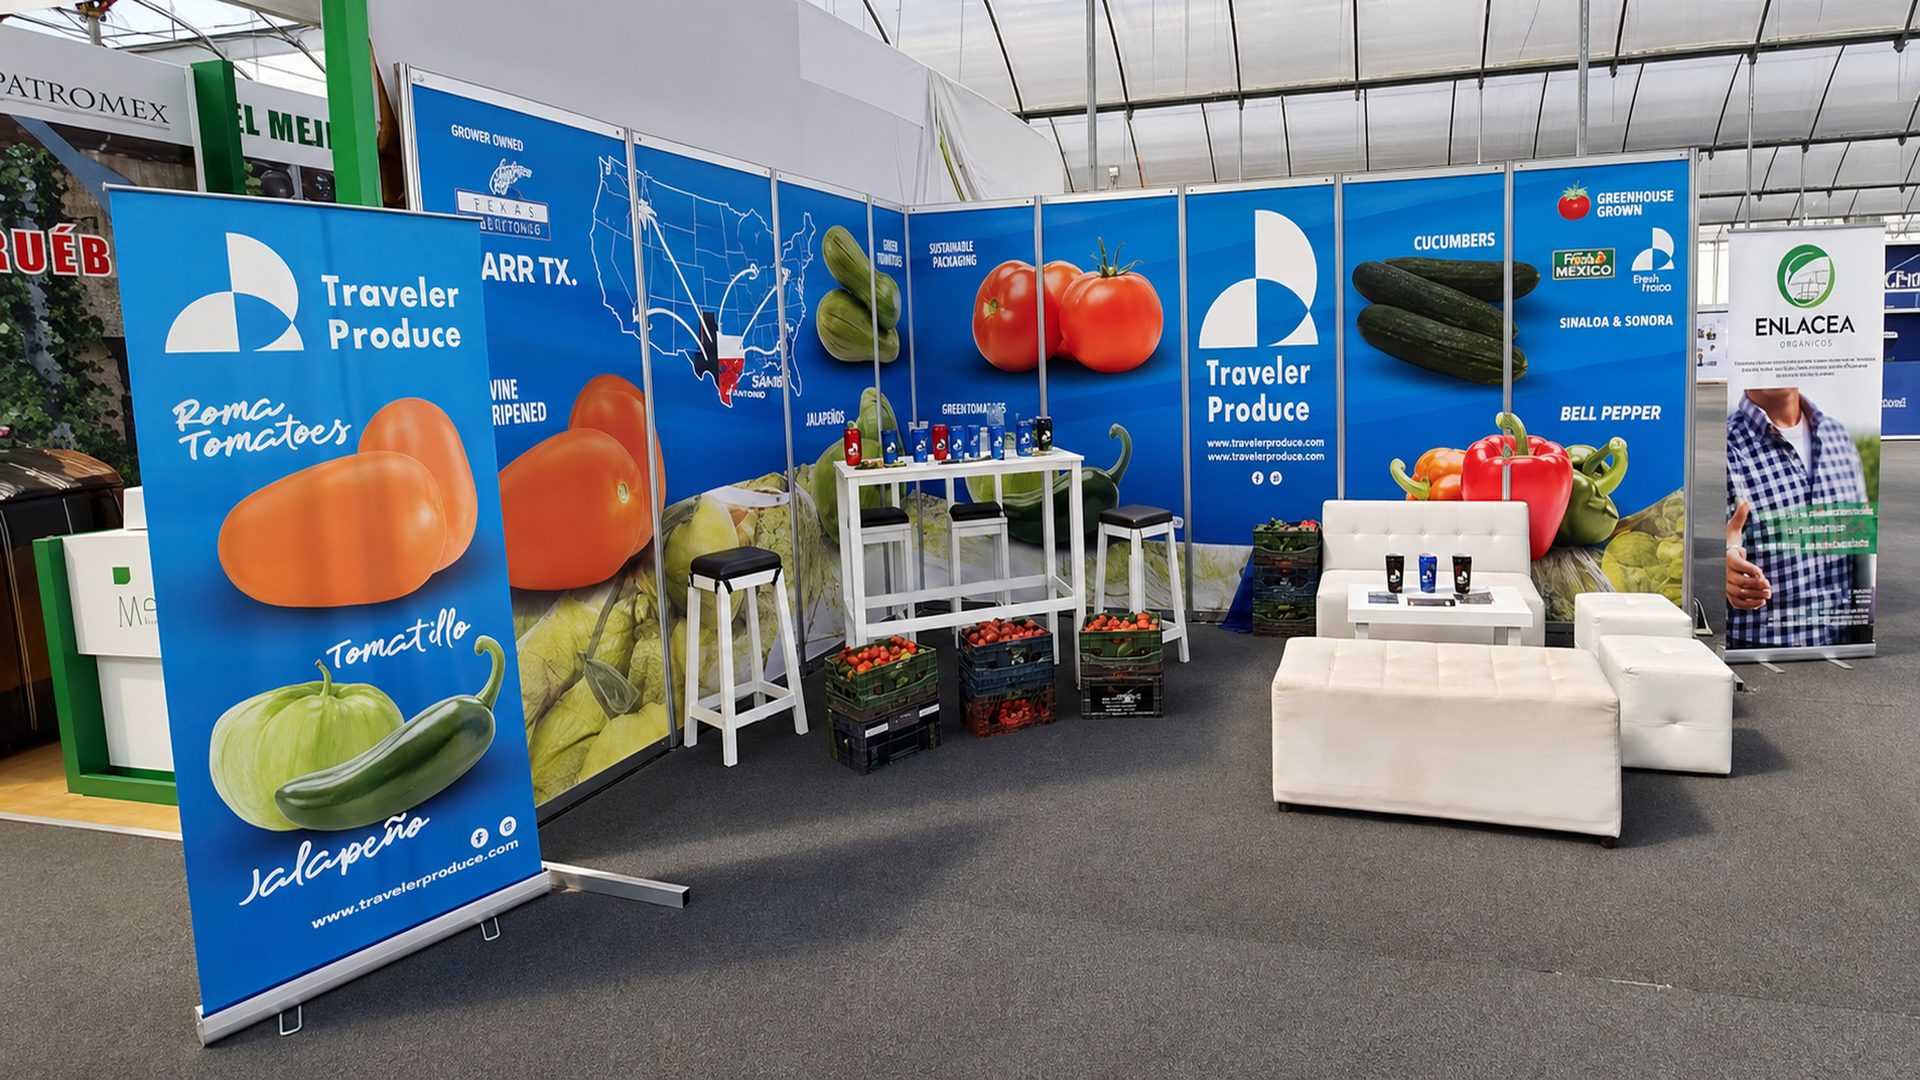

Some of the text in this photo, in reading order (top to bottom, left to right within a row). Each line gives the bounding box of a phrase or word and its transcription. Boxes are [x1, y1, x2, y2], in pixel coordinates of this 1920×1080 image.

[268, 109, 332, 149] MEJ
[451, 124, 524, 152] GROWER OWNED
[1597, 190, 1674, 204] GREENHOUSE
[1597, 203, 1643, 218] GROWN
[929, 241, 974, 254] SUSTAINABLE
[1414, 232, 1496, 250] CUCUMBERS
[538, 256, 577, 286] TX.
[932, 254, 977, 268] PACKAGING
[1556, 265, 1612, 277] MEXICO
[321, 274, 459, 308] Traveler
[328, 317, 462, 350] Produce
[1559, 315, 1673, 329] SINALOA & SONORA
[1755, 315, 1855, 337] ENLACEA
[1206, 355, 1311, 386] Traveler
[489, 378, 519, 401] VINE
[171, 397, 286, 432] Roma
[491, 401, 547, 426] RIPENED
[805, 410, 845, 427] JALAPEÑOS
[1208, 393, 1310, 423] Produce
[1560, 405, 1662, 421] BELL PEPPER
[178, 414, 352, 461] Tomatoes
[1206, 438, 1325, 449] www.travelerproduce.com
[1206, 452, 1325, 462] www.travelerproduce.com
[326, 607, 471, 669] Tomatillo
[239, 812, 430, 907] Jalapeño
[311, 839, 519, 930] www.travelerproduce.com
